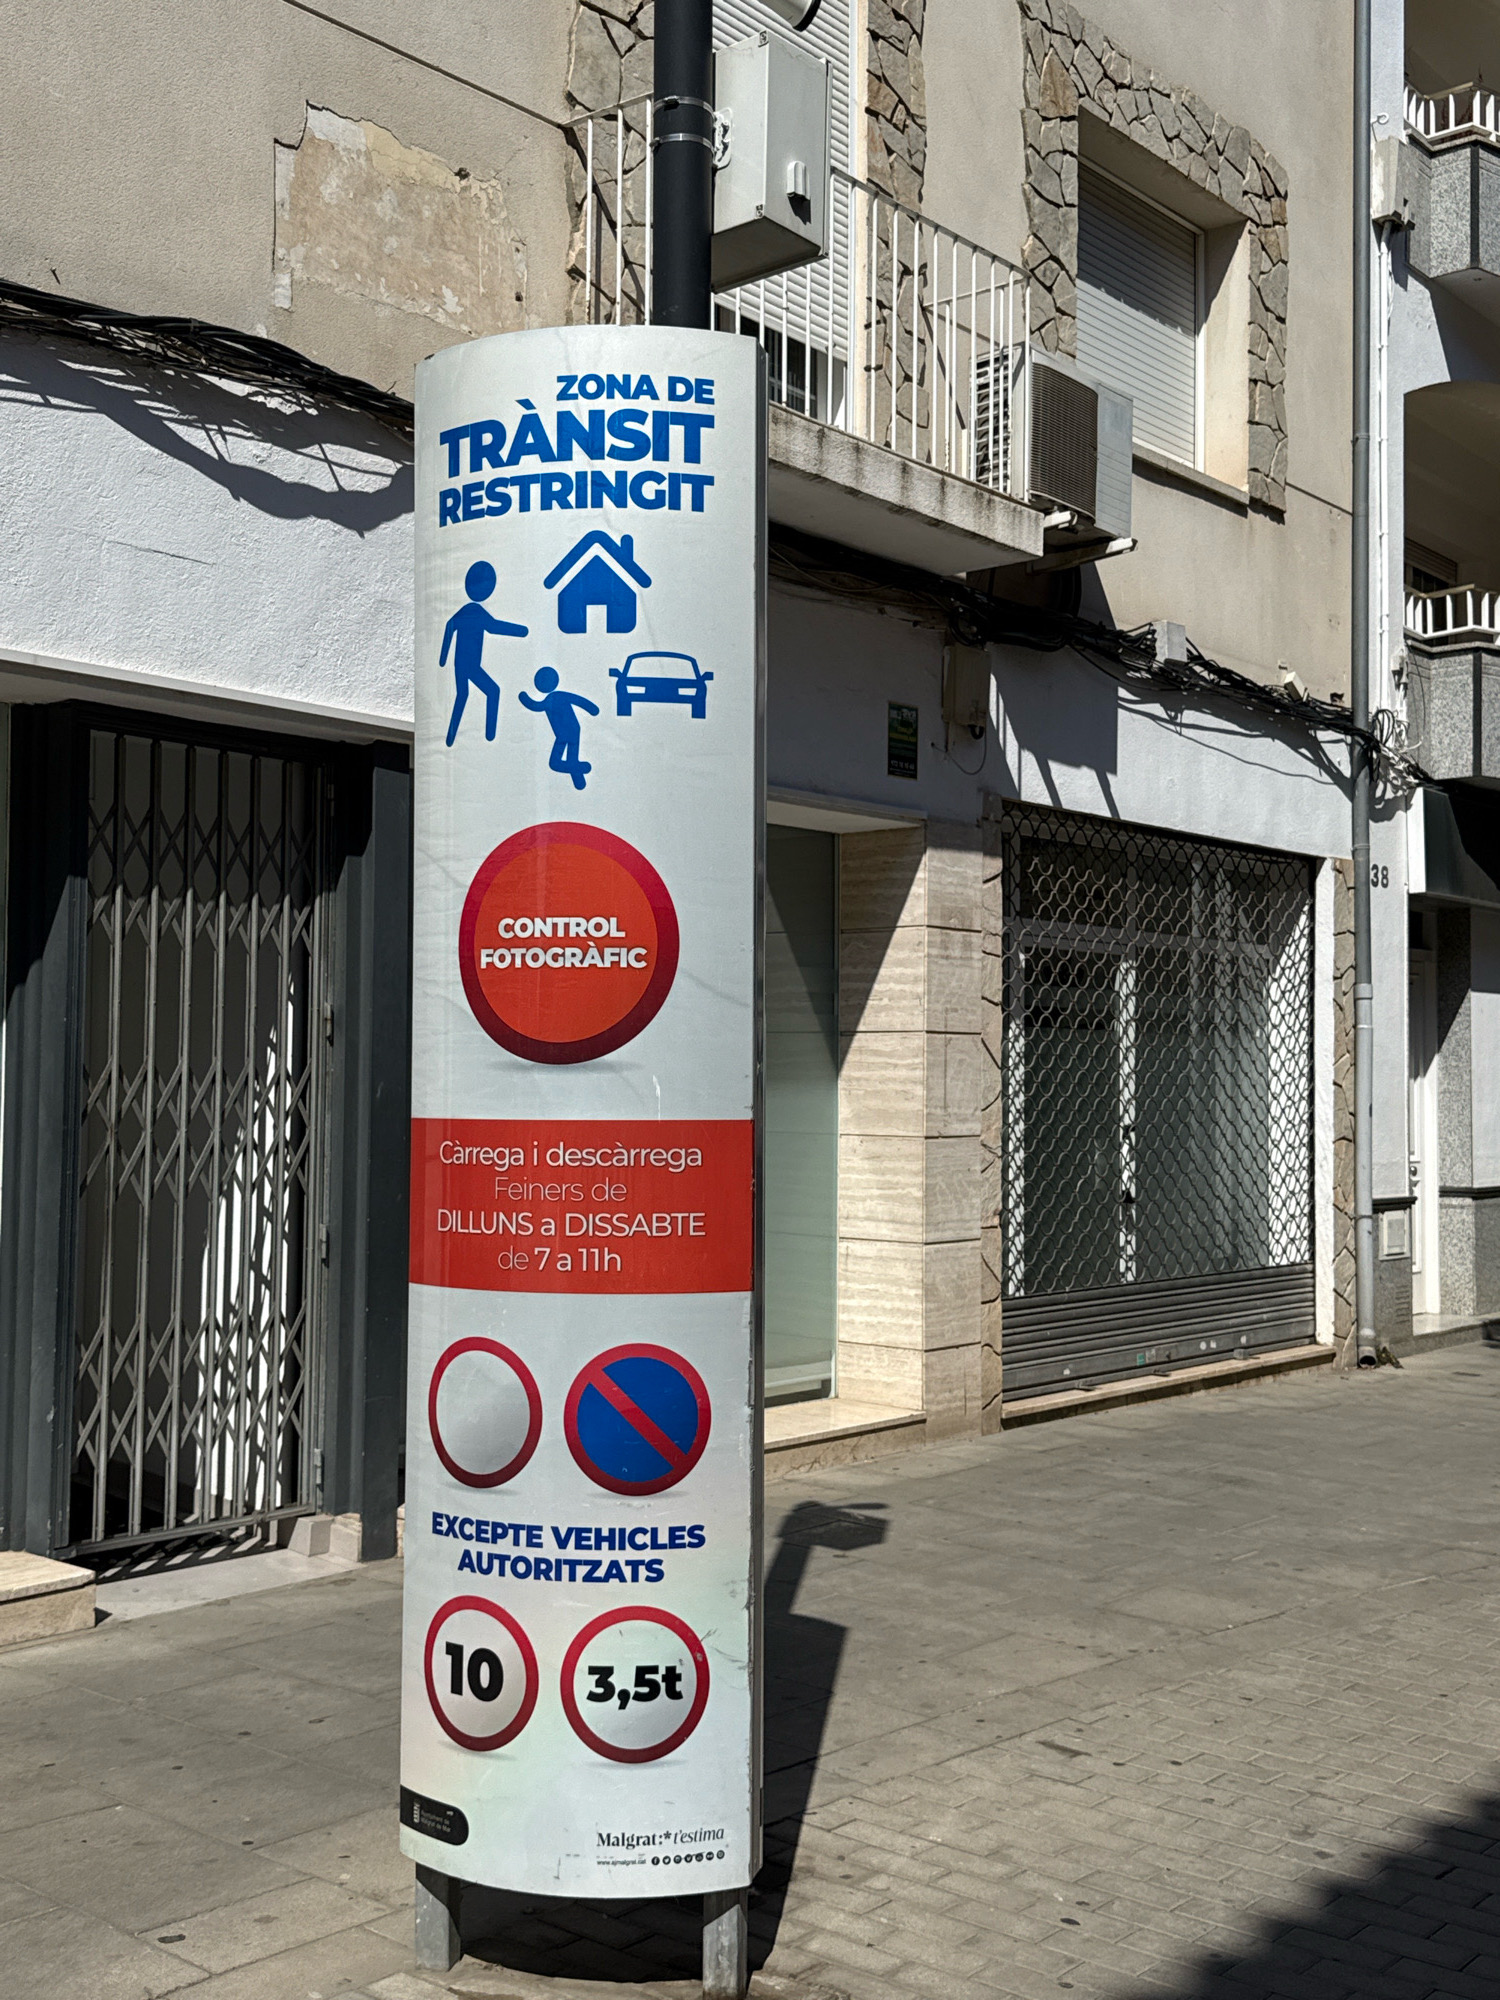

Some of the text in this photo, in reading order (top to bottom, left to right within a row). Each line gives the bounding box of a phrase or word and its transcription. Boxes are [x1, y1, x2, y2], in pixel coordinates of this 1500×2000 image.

[556, 374, 715, 405] ZONA DE
[439, 398, 715, 478] TRÀNSIT
[439, 470, 715, 528] RESTRINGIT
[1371, 863, 1389, 888] 38
[498, 916, 626, 939] CONTROL
[480, 941, 648, 969] FOTOGRÀFIC
[439, 1140, 703, 1173] Càrrega i descàrrega
[494, 1176, 627, 1202] Feiners de
[437, 1208, 706, 1238] DILLUNS a DISSABTE
[498, 1245, 622, 1272] de 7 a 11h
[431, 1511, 706, 1551] EXCEPTE VEHICLES
[457, 1549, 665, 1583] AUTORITZATS
[445, 1640, 504, 1702] 10
[586, 1664, 684, 1711] 3,5t
